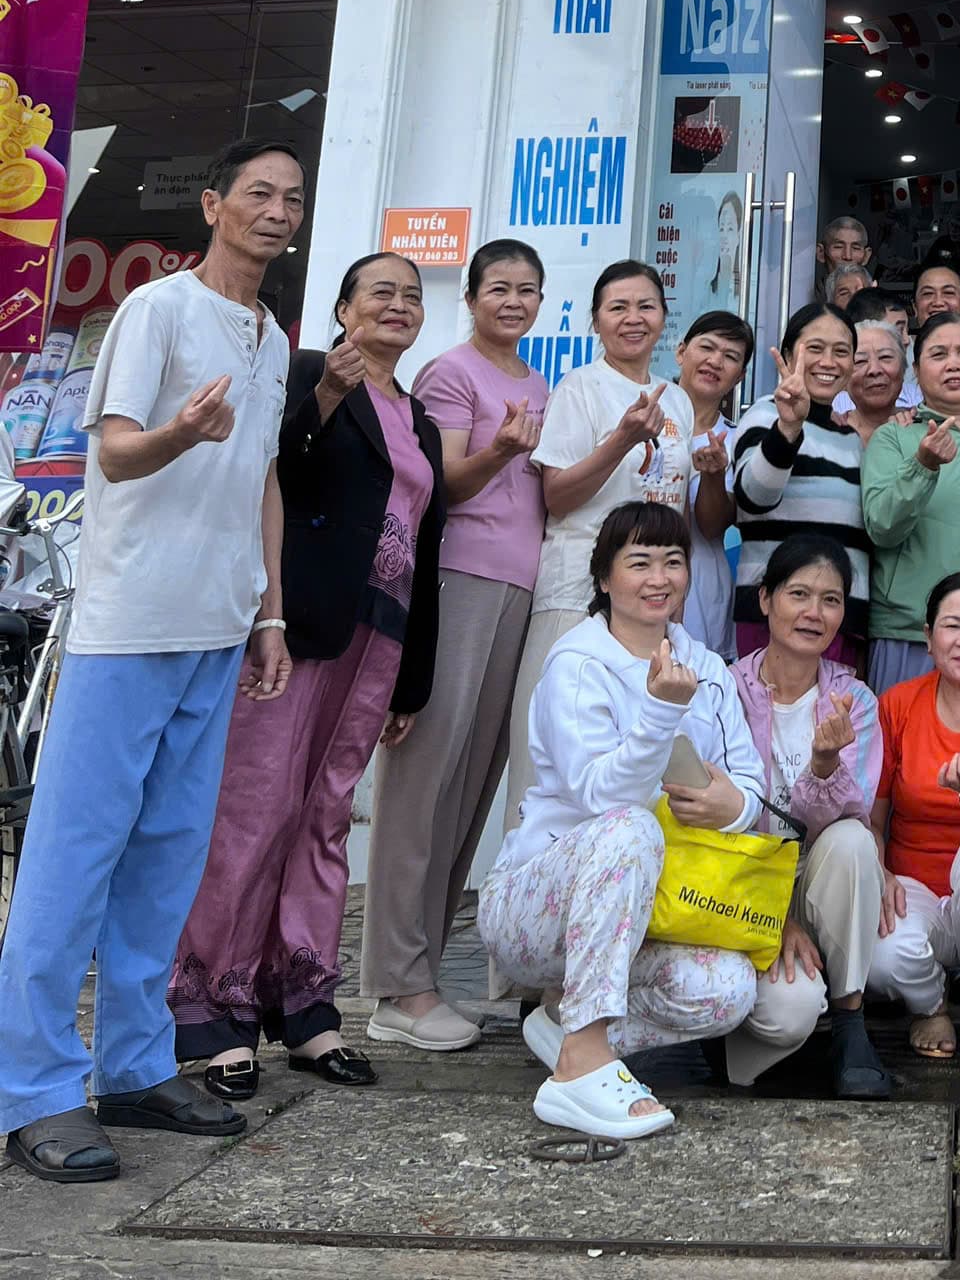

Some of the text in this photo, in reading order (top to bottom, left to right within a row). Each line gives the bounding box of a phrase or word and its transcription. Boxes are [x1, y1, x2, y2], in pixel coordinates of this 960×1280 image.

[509, 117, 627, 247] NGHIỆM
[659, 202, 674, 220] Cải
[407, 212, 447, 231] TUYỂN
[392, 233, 458, 249] NHÂN VIÊN
[657, 226, 680, 245] thiện
[656, 249, 678, 268] cuộc
[661, 269, 676, 289] ống
[63, 385, 89, 398] Apt
[678, 886, 740, 919] Michael
